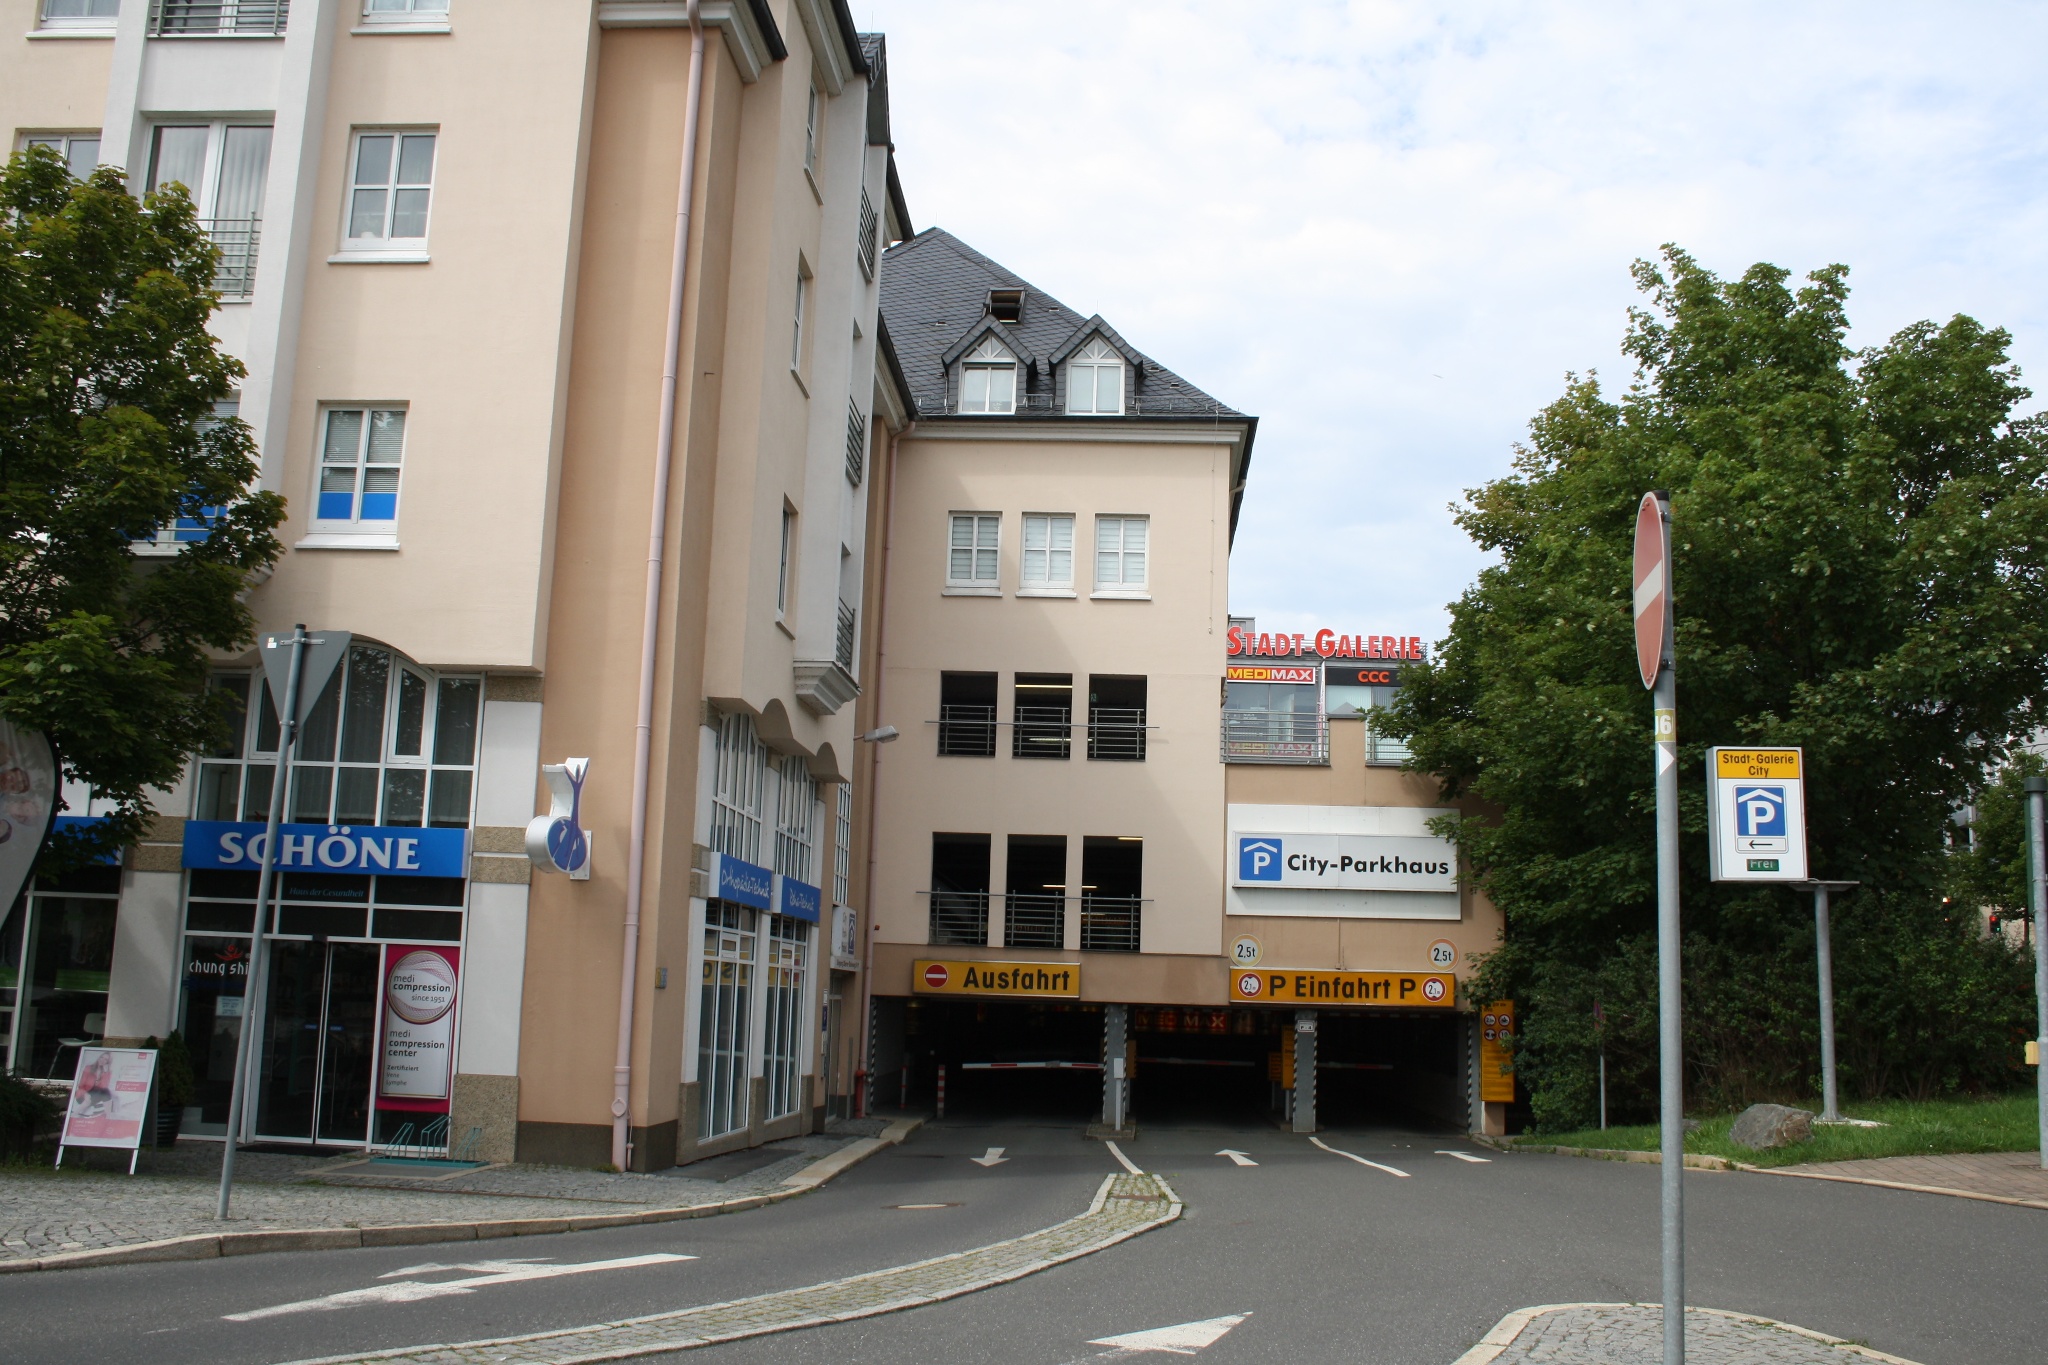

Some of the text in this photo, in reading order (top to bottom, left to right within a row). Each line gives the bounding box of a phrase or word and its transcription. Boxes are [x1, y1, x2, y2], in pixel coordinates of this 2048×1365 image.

[1228, 626, 1422, 660] STADT-GALERIE
[1228, 668, 1312, 682] MEDIMAX
[1358, 671, 1390, 683] CCC
[1722, 753, 1795, 765] Stadt-Galerie
[1748, 766, 1770, 778] City
[1747, 801, 1775, 835] P
[218, 825, 421, 870] SCHÖNE
[1253, 852, 1449, 876] P City-Parkhaus
[322, 888, 365, 898] Gesundheit
[189, 960, 249, 976] chung shi
[393, 974, 415, 983] medi
[963, 966, 1070, 991] Ausfahrt
[393, 983, 451, 993] compression
[1270, 975, 1416, 1000] P Einfahrt P
[411, 994, 430, 1002] since
[390, 1030, 411, 1038] medi
[389, 1040, 445, 1050] compression
[388, 1049, 418, 1057] center
